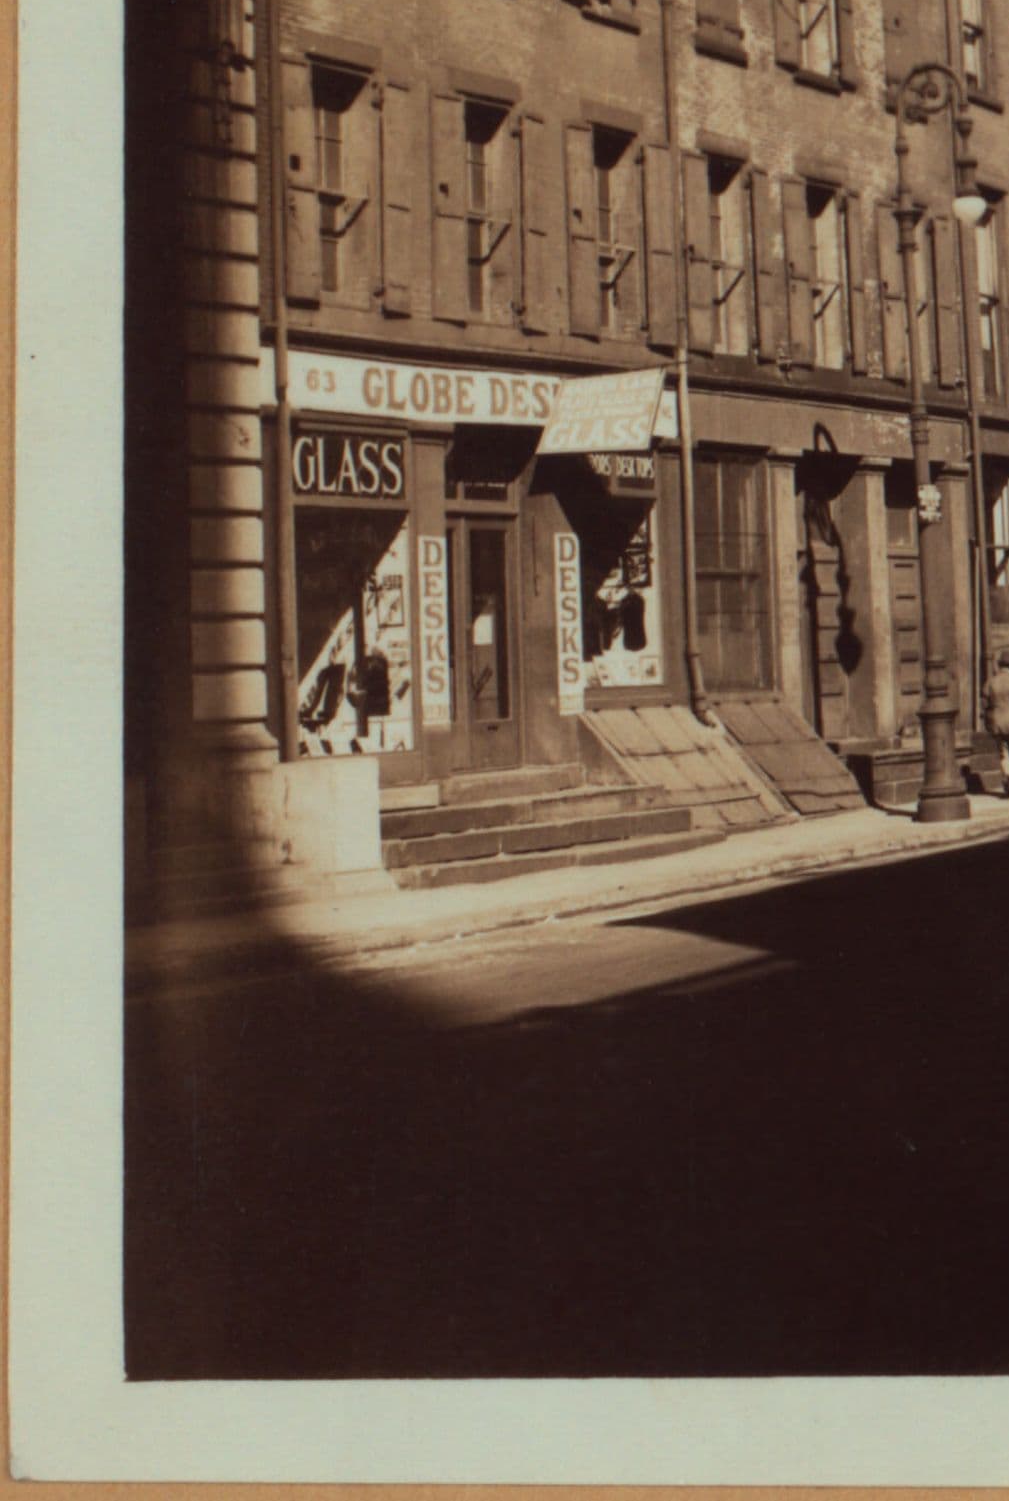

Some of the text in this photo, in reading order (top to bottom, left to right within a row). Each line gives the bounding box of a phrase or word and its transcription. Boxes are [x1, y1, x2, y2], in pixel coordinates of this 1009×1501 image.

[306, 368, 336, 394] 63
[362, 366, 475, 415] GLOBE
[489, 376, 561, 420] DES
[544, 415, 650, 448] GLASS
[292, 435, 402, 496] GLASS
[422, 539, 446, 694] DESKS
[558, 535, 581, 685] DESKS
